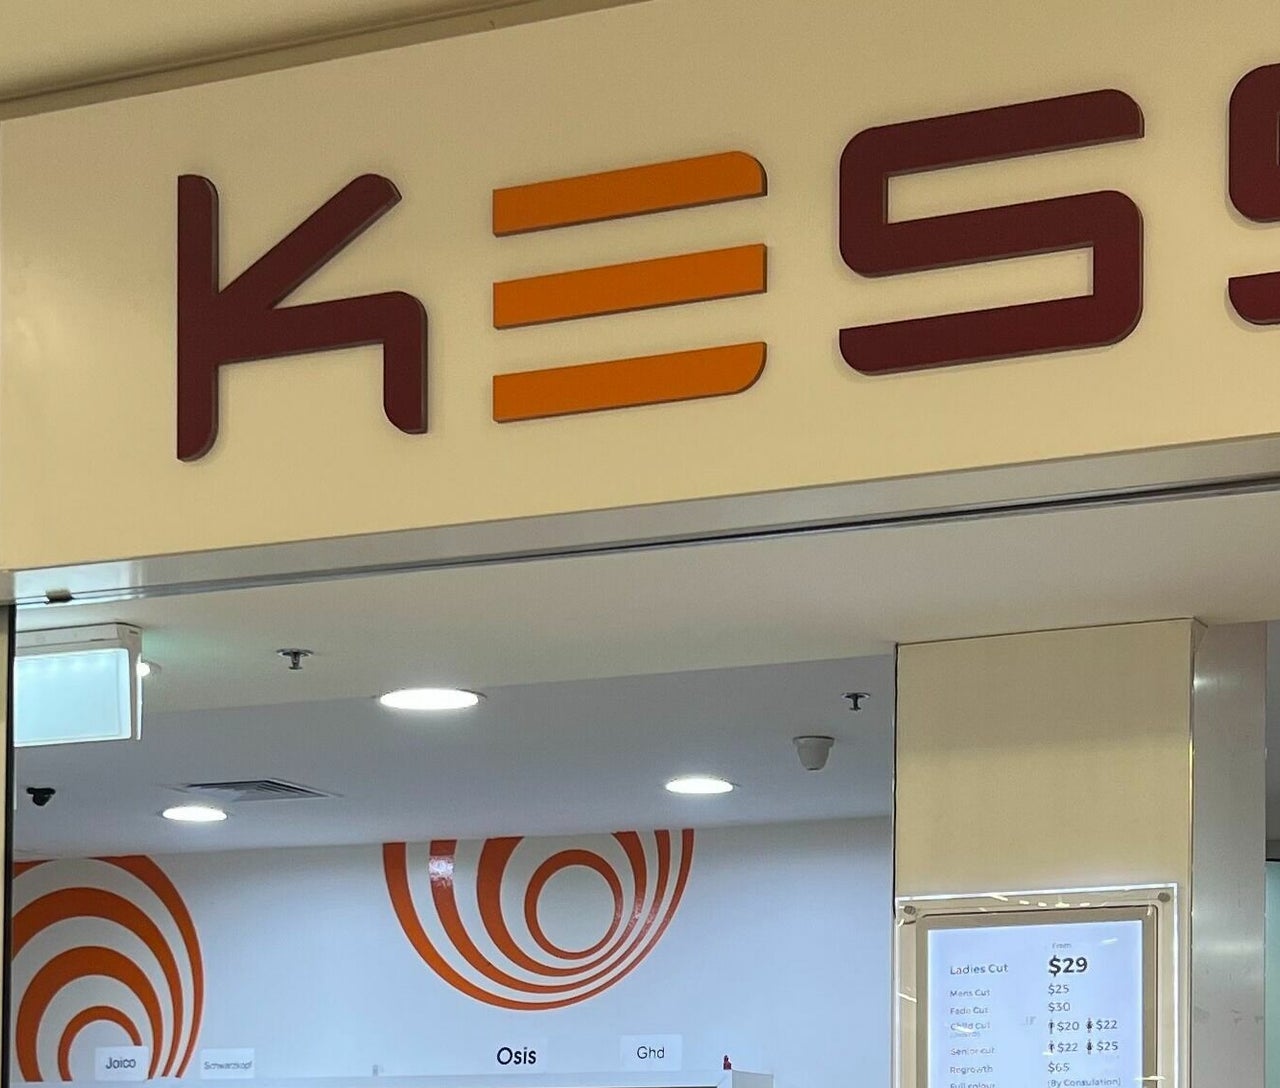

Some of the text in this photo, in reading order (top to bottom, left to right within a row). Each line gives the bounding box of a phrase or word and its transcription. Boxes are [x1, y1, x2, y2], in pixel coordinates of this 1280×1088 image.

[949, 955, 1088, 977] Ladies Cut $29
[949, 983, 1070, 997] Mens Cut $25
[972, 1006, 989, 1014] Cut
[1048, 1001, 1071, 1013] $30
[1056, 1021, 1080, 1032] $20
[1095, 1019, 1118, 1031] $22
[636, 1045, 665, 1060] Ghd
[1057, 1042, 1078, 1053] $22
[1096, 1040, 1119, 1052] $25
[496, 1046, 537, 1066] Osis
[105, 1057, 137, 1070] Joico
[1047, 1061, 1070, 1074] $65
